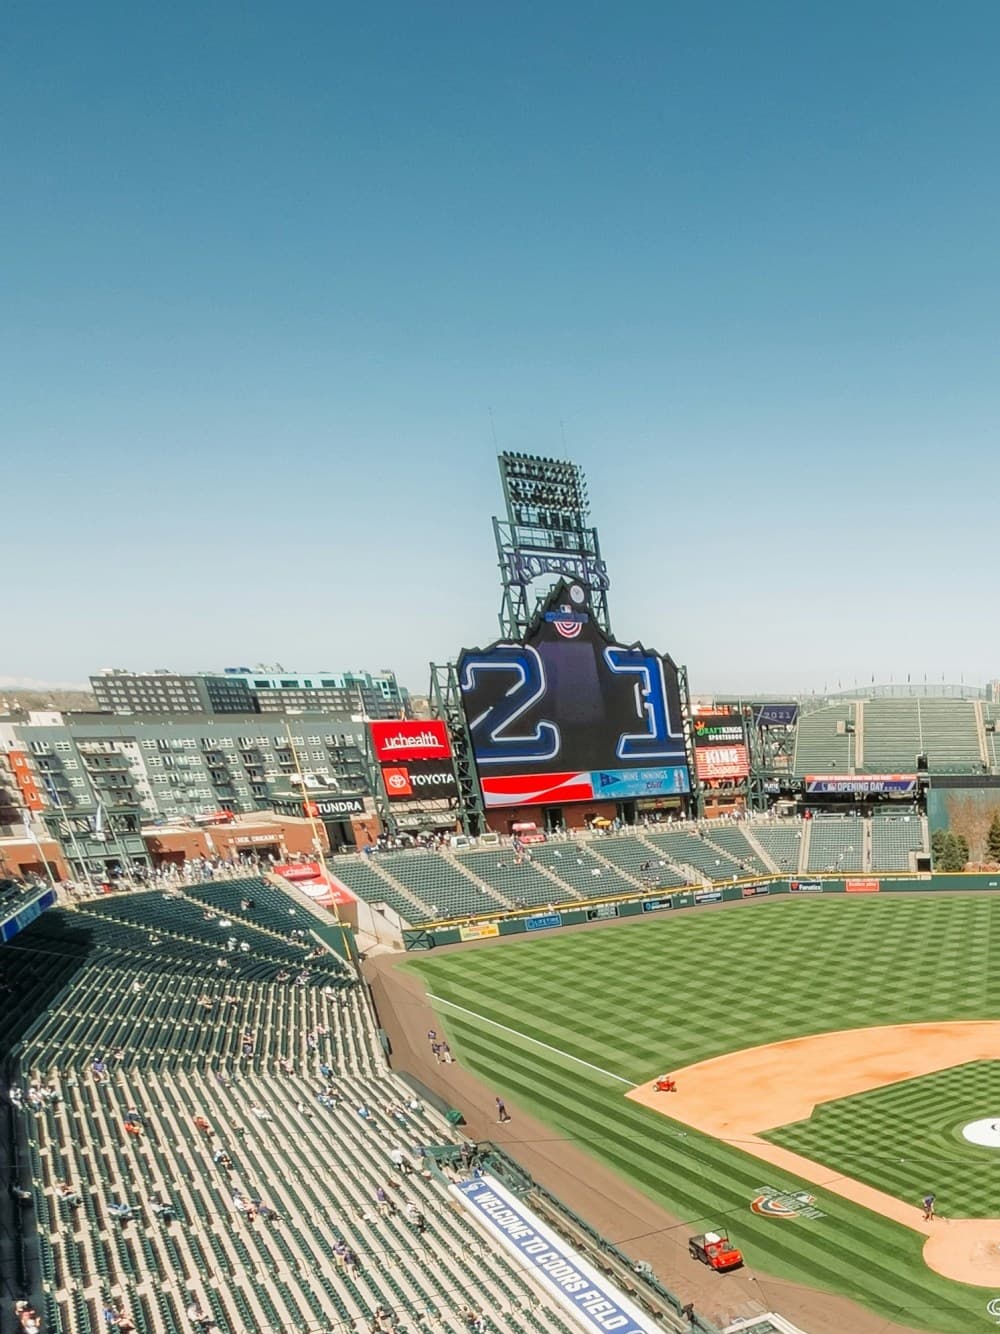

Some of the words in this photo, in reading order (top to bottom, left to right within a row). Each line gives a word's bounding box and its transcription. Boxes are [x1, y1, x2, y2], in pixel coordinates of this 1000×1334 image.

[384, 731, 439, 748] uchealth
[409, 774, 455, 785] TOYOTA
[837, 782, 869, 791] OPENING
[870, 782, 885, 791] DAY
[317, 801, 362, 813] TUNDRA
[474, 1191, 534, 1240] WELCOME
[520, 1233, 550, 1254] TO
[535, 1252, 590, 1293] COORS
[579, 1292, 629, 1331] FIELD
